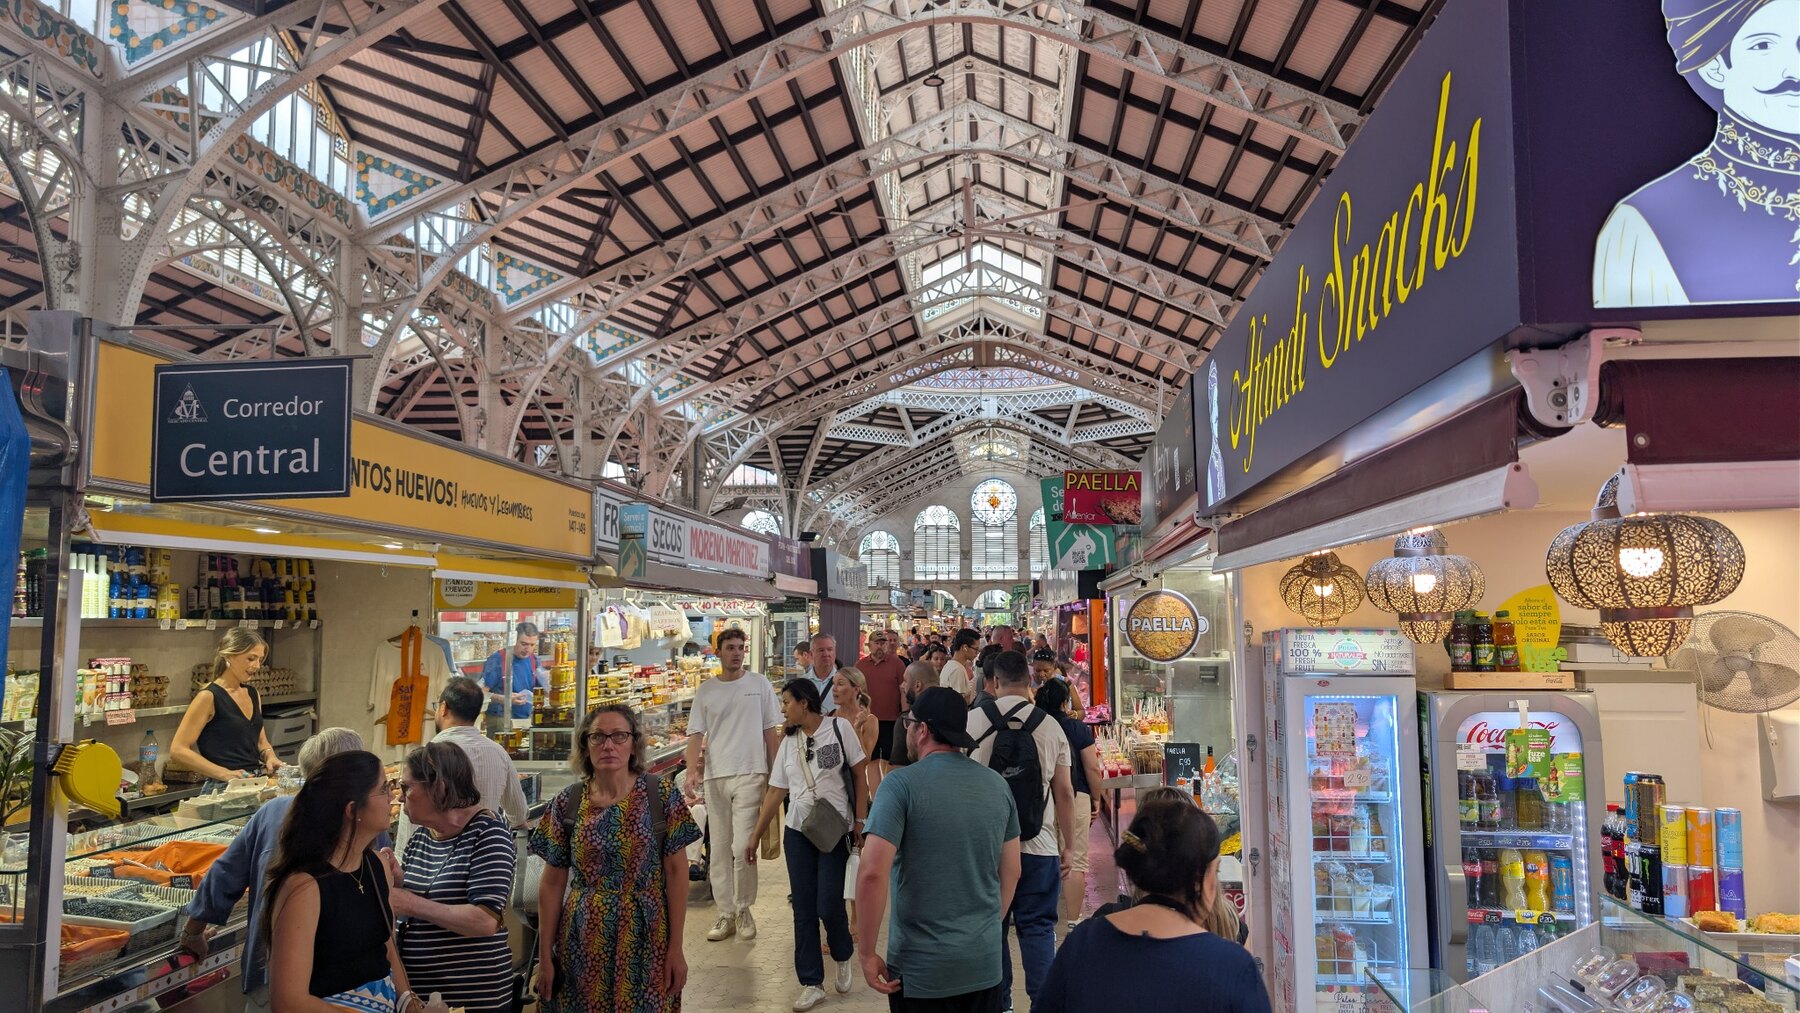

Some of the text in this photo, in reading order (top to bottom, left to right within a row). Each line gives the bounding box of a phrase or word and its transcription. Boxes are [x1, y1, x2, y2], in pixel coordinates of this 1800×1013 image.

[1318, 71, 1482, 369] Snacks
[223, 395, 324, 419] Corredor
[180, 437, 320, 478] Central
[395, 468, 458, 507] HUEVOS!
[1066, 472, 1138, 491] PAELLA
[652, 518, 682, 553] SECOS
[690, 526, 725, 563] MORENO
[725, 536, 759, 571] MARTINEZ
[1518, 603, 1552, 611] sabor de
[1519, 611, 1552, 619] siempre
[1131, 617, 1194, 632] PAELLA
[1293, 641, 1317, 649] FRESCA
[1290, 649, 1322, 657] 100 %
[1294, 664, 1315, 672] FRUIT
[1372, 659, 1387, 671] SIN
[1528, 749, 1546, 758] fuze
